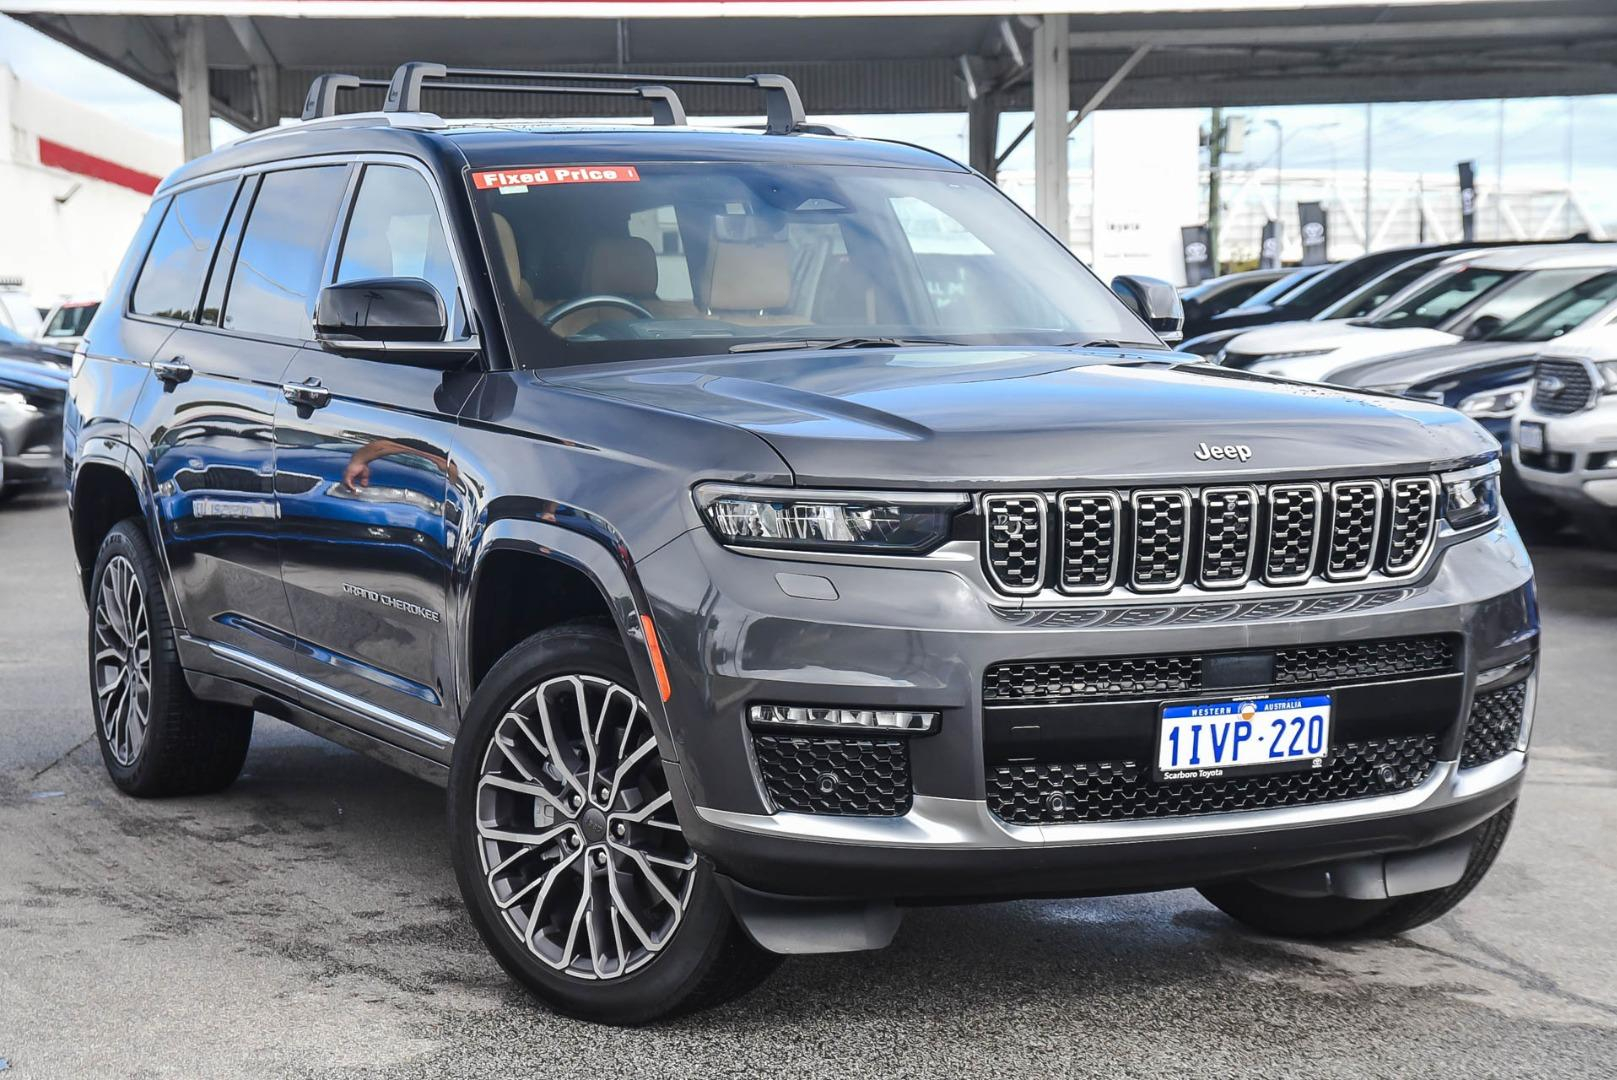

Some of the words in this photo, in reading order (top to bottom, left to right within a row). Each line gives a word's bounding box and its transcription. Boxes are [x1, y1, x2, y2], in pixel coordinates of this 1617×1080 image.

[483, 172, 548, 186] Fixed
[555, 169, 617, 181] Price
[1194, 442, 1252, 463] Jeep
[342, 582, 378, 602] GRAND
[380, 595, 439, 622] CHEROKEE
[1191, 707, 1231, 716] WESTERN
[1264, 701, 1302, 711] AUSTRALIA
[1163, 771, 1198, 780] Scarboro
[1198, 769, 1223, 779] Toyota
